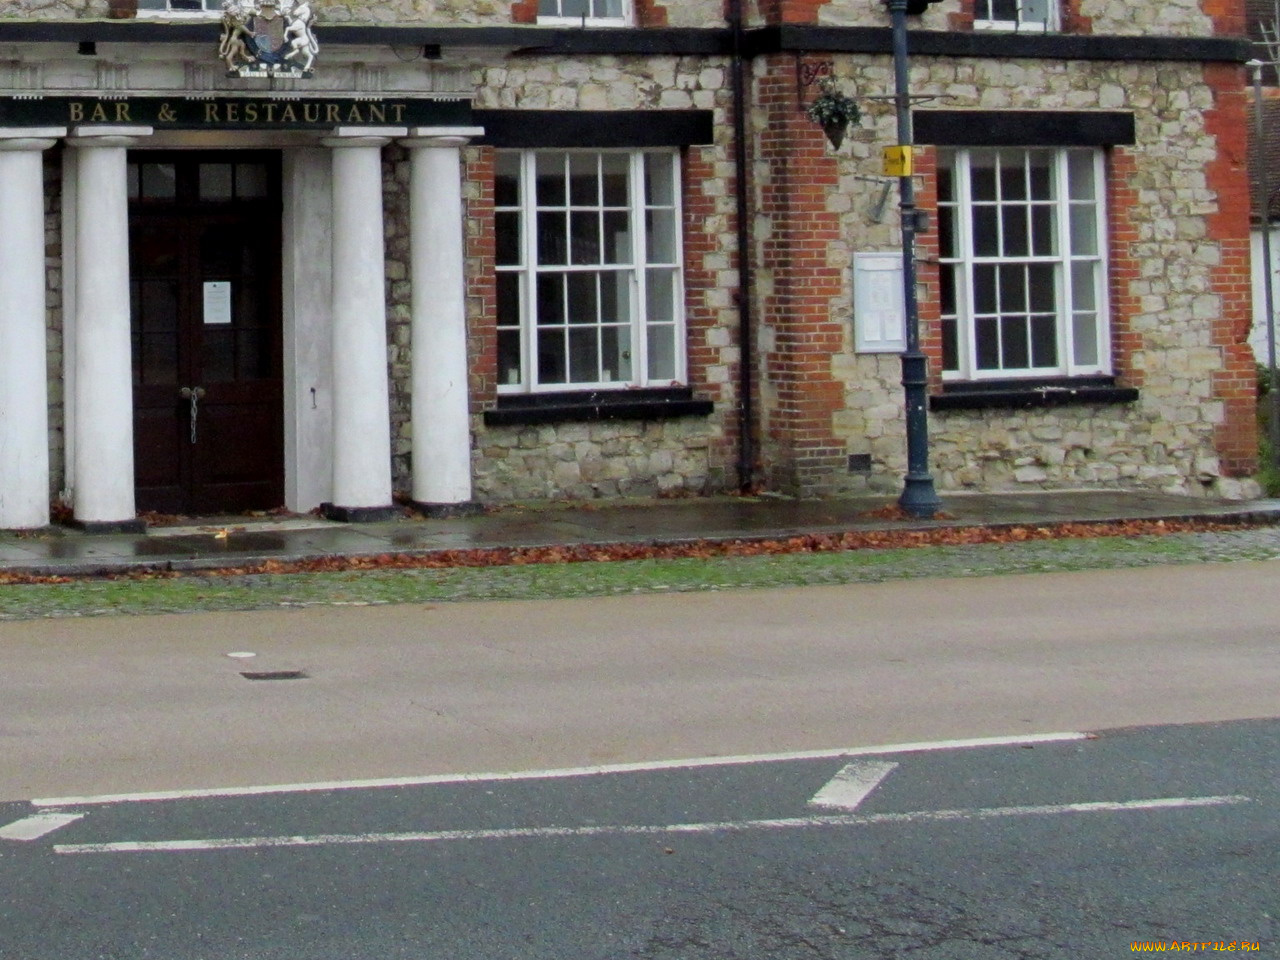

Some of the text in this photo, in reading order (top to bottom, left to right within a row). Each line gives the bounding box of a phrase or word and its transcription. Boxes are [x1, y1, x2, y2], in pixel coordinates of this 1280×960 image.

[69, 102, 407, 123] BAR & RESTAURANT
